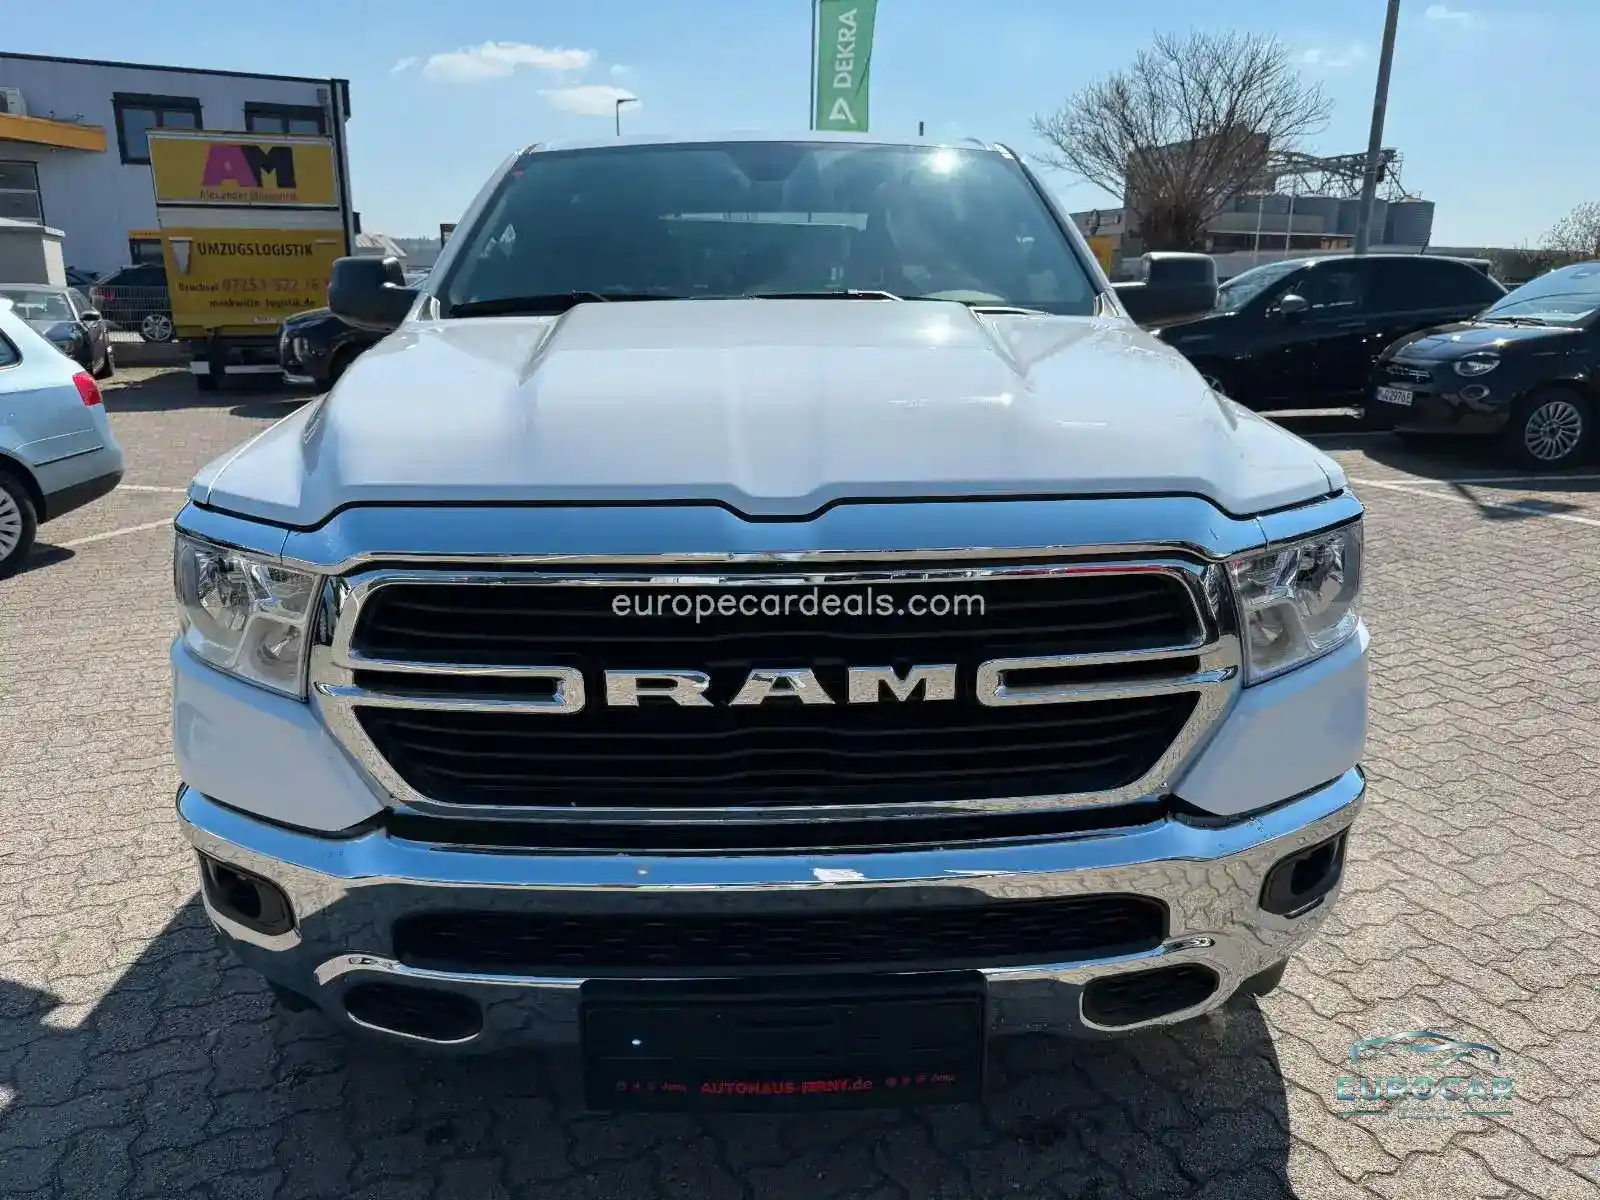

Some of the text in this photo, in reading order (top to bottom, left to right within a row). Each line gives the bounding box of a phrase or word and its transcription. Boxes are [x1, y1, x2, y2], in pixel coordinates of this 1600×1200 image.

[832, 8, 858, 88] DEKRA
[201, 144, 296, 188] AM
[197, 242, 313, 257] UMZUGSLOGISTIK
[604, 663, 957, 707] RAM
